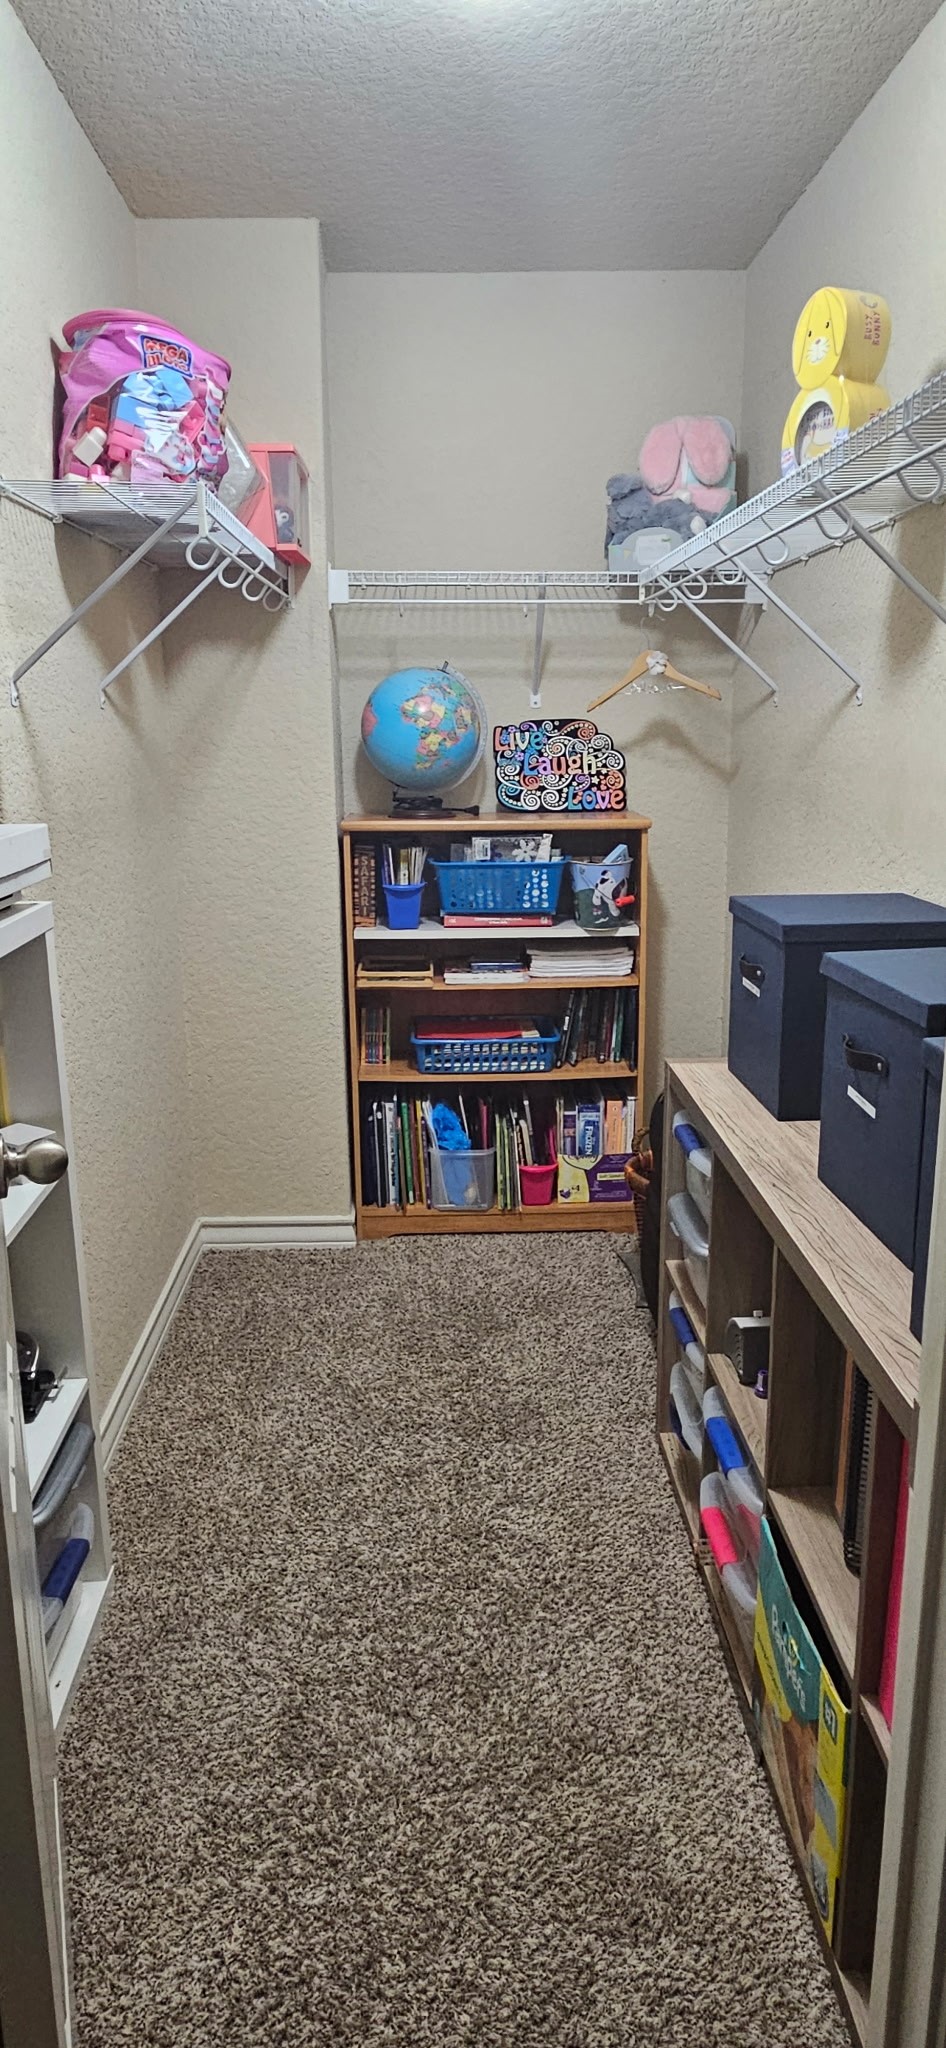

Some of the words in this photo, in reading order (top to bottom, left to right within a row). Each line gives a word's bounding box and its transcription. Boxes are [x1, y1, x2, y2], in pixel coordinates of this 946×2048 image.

[864, 313, 873, 340] BUSY
[872, 310, 881, 346] BUNNY
[144, 339, 188, 363] MEGA
[494, 727, 544, 751] Live
[524, 751, 597, 775] Laugh
[568, 786, 625, 810] Love
[360, 855, 369, 916] SAFARI
[585, 1126, 594, 1155] FROZEN
